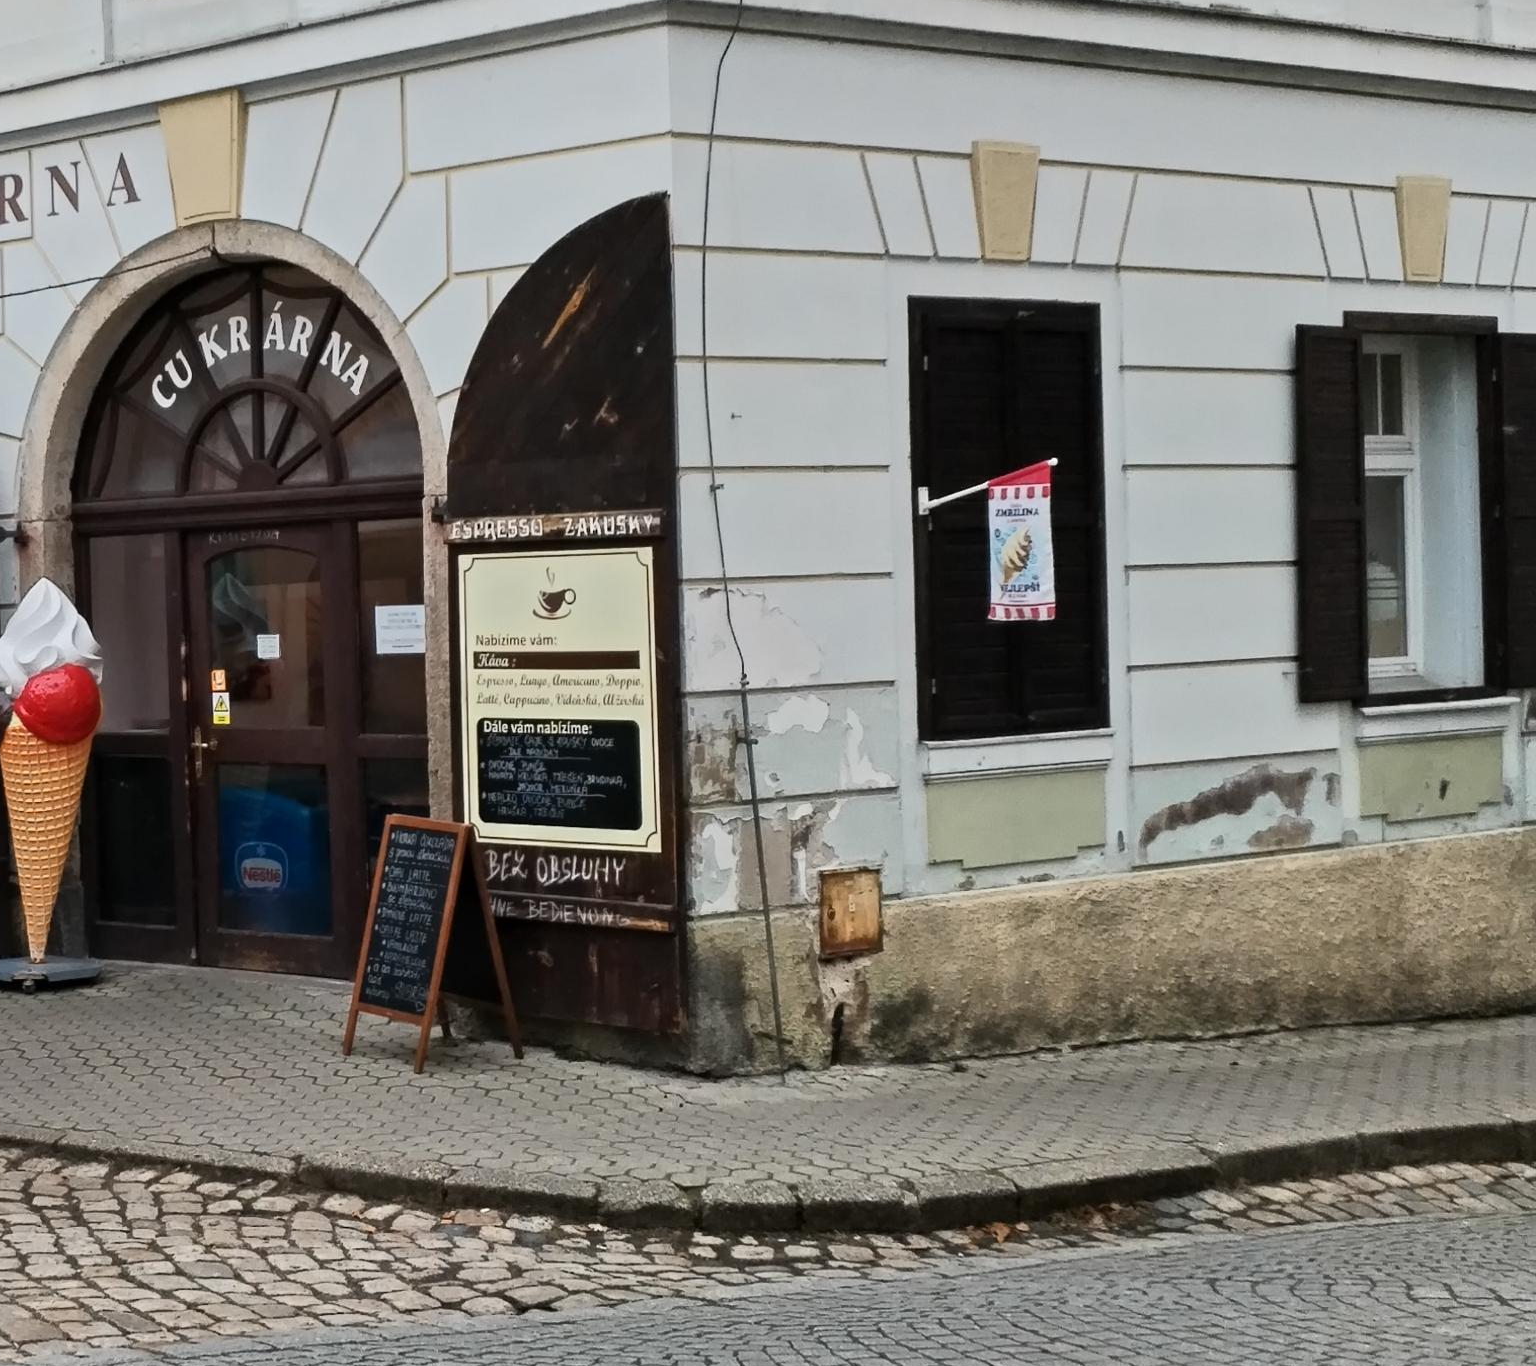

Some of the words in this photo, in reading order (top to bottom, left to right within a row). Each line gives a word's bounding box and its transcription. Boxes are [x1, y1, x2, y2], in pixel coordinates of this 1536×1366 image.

[151, 300, 369, 409] CUKRÁRNA
[449, 519, 544, 541] ESPRESSO
[563, 514, 654, 537] ZAKUSKY
[475, 635, 527, 647] Nabízíme
[530, 633, 558, 646] vám:
[477, 653, 510, 668] Káva
[483, 721, 508, 733] Dále
[511, 721, 535, 733] vám
[537, 721, 593, 735] nabízíme:
